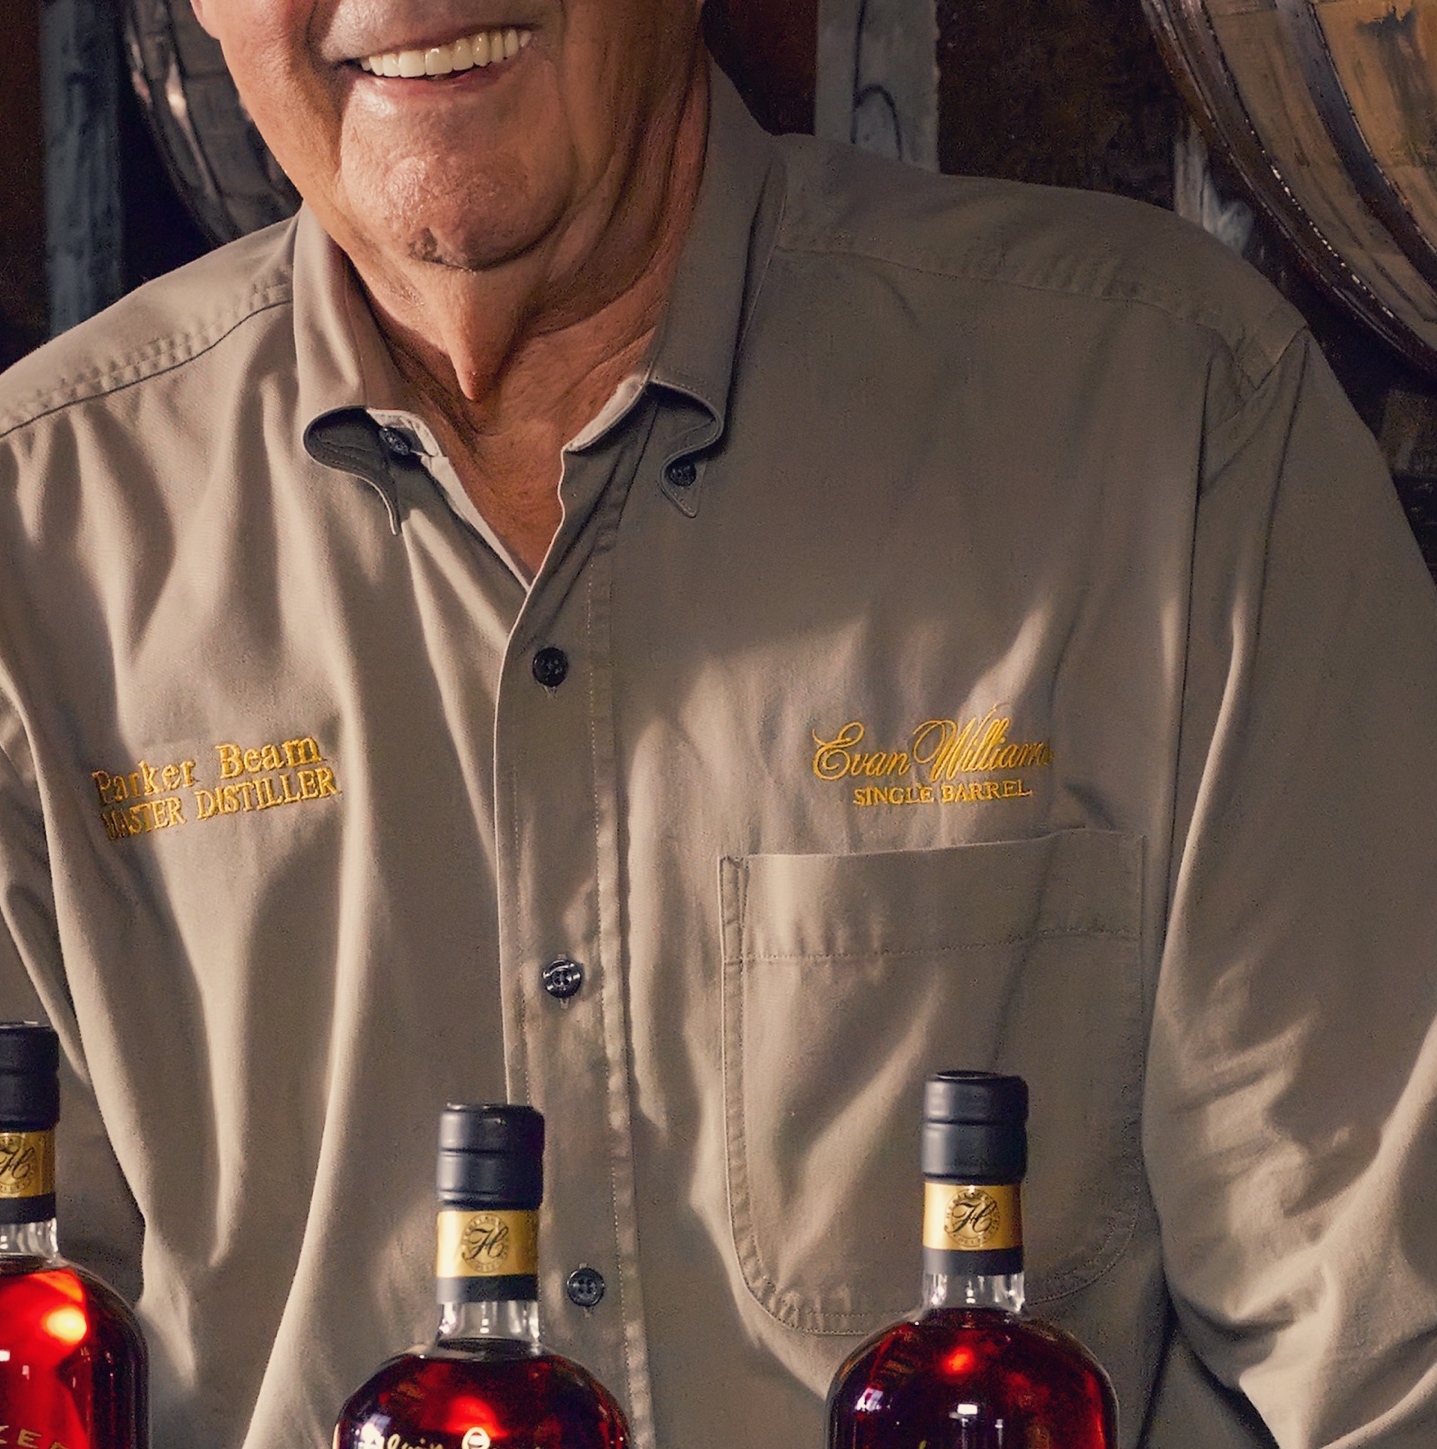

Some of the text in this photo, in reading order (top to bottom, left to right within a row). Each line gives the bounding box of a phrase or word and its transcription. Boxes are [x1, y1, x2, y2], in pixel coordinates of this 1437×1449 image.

[92, 737, 325, 805] Parker Beam
[813, 721, 913, 780] Evan
[194, 766, 340, 820] DISTILLER
[853, 779, 1032, 805] SINGLE BARREL
